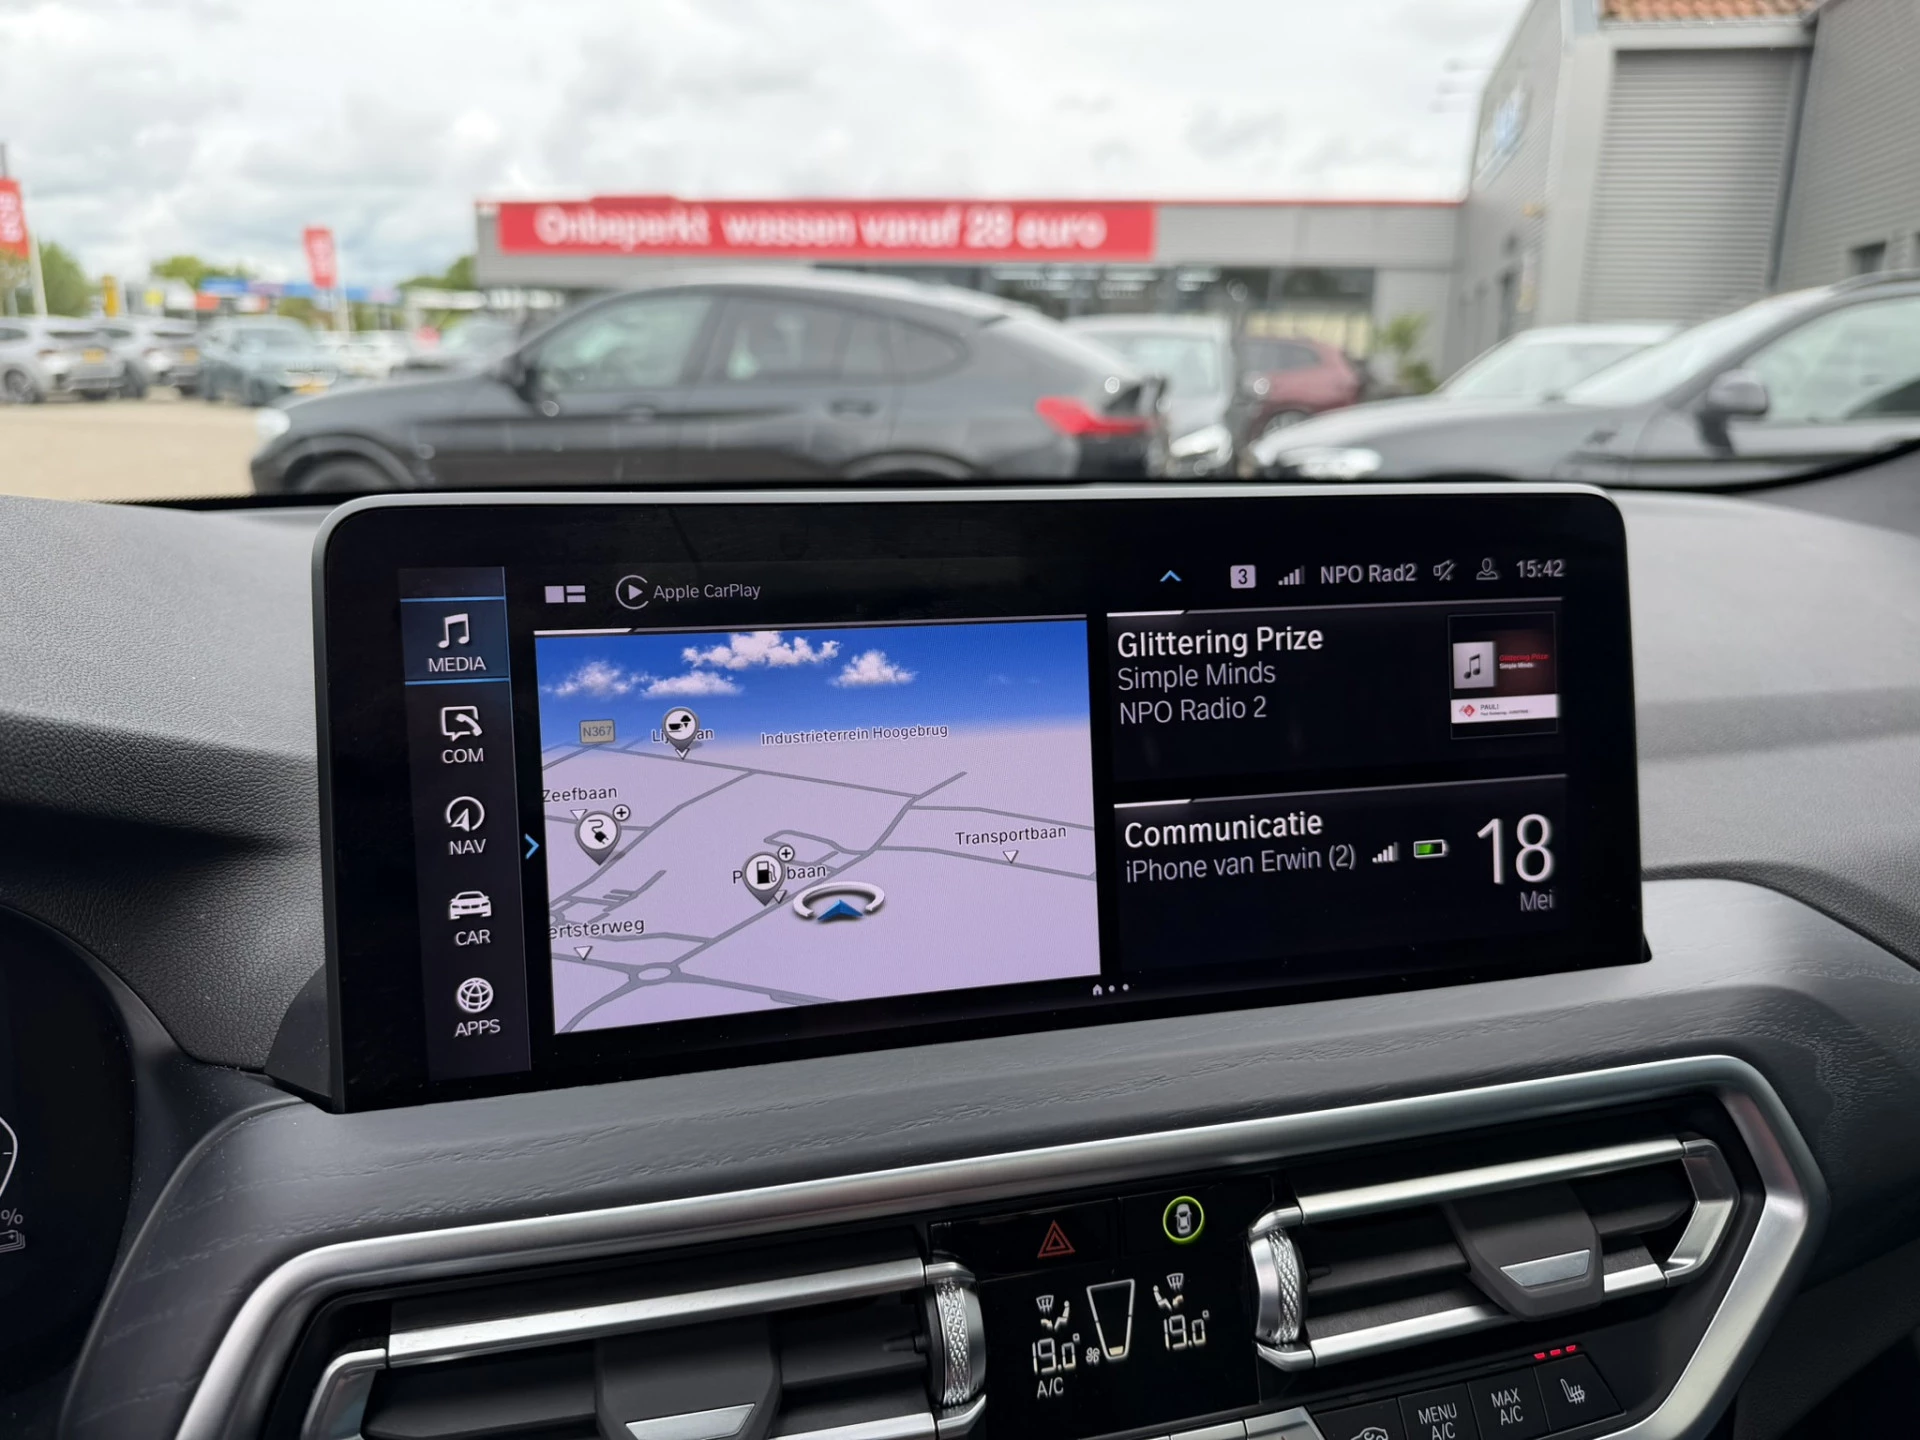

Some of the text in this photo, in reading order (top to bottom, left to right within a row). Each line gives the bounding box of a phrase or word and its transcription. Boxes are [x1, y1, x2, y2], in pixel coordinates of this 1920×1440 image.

[535, 206, 710, 250] Onbeperkt
[721, 212, 855, 247] wassen
[861, 207, 960, 247] vanaf
[1018, 214, 1105, 248] euro
[1237, 568, 1249, 585] 3
[1320, 563, 1417, 584] NPO Rad2
[1516, 560, 1565, 578] 15:42
[653, 583, 761, 601] Apple CarPlay
[1117, 626, 1324, 658] Glittering Prize
[428, 656, 487, 673] MEDIA
[1118, 662, 1276, 691] Simple Minds
[1120, 696, 1268, 724] NPO Radio 2
[583, 725, 613, 738] N367
[761, 725, 948, 745] Industrieterrein Hoogebrug
[442, 749, 484, 763] COM
[542, 787, 617, 802] Zeefbaan
[955, 827, 1067, 846] Transportbaan
[1125, 811, 1323, 848] Communicatie
[449, 839, 486, 855] NAV
[1477, 814, 1554, 884] 18
[1126, 844, 1356, 883] iPhone van Erwin (2)
[1520, 890, 1554, 911] Mei
[455, 929, 490, 945] CAR
[549, 919, 645, 939] ertsterweg
[455, 1020, 501, 1037] APPS
[1037, 1377, 1064, 1398] A/C
[1491, 1388, 1521, 1408] MAX
[1418, 1403, 1457, 1425] MENU
[1500, 1406, 1523, 1426] A/C
[1431, 1422, 1455, 1440] A/C
